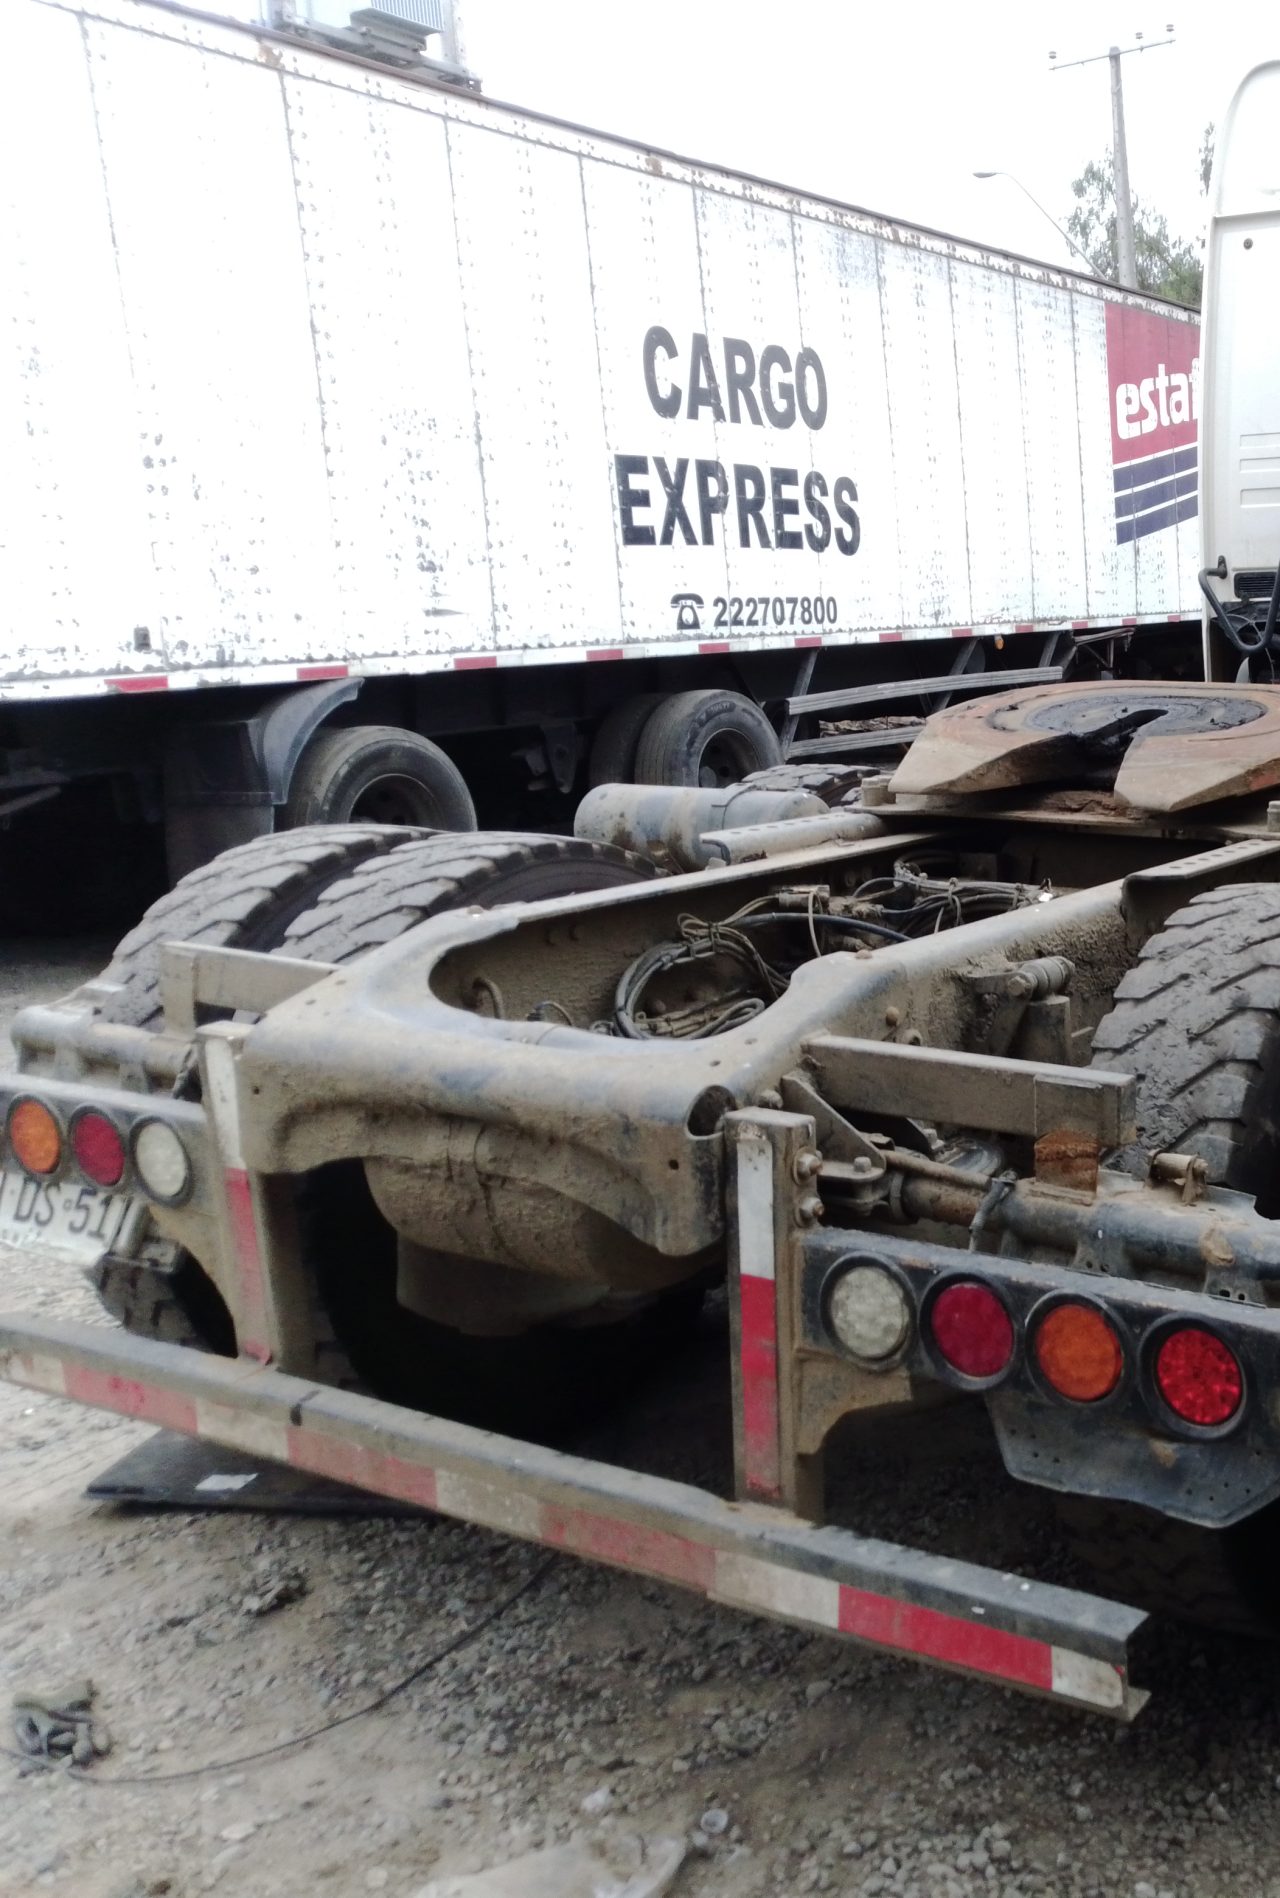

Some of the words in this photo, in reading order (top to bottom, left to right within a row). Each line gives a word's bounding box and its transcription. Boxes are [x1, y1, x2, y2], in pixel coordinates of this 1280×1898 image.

[642, 325, 829, 431] CARGO
[613, 453, 862, 557] EXPRESS
[712, 596, 839, 628] 222707800
